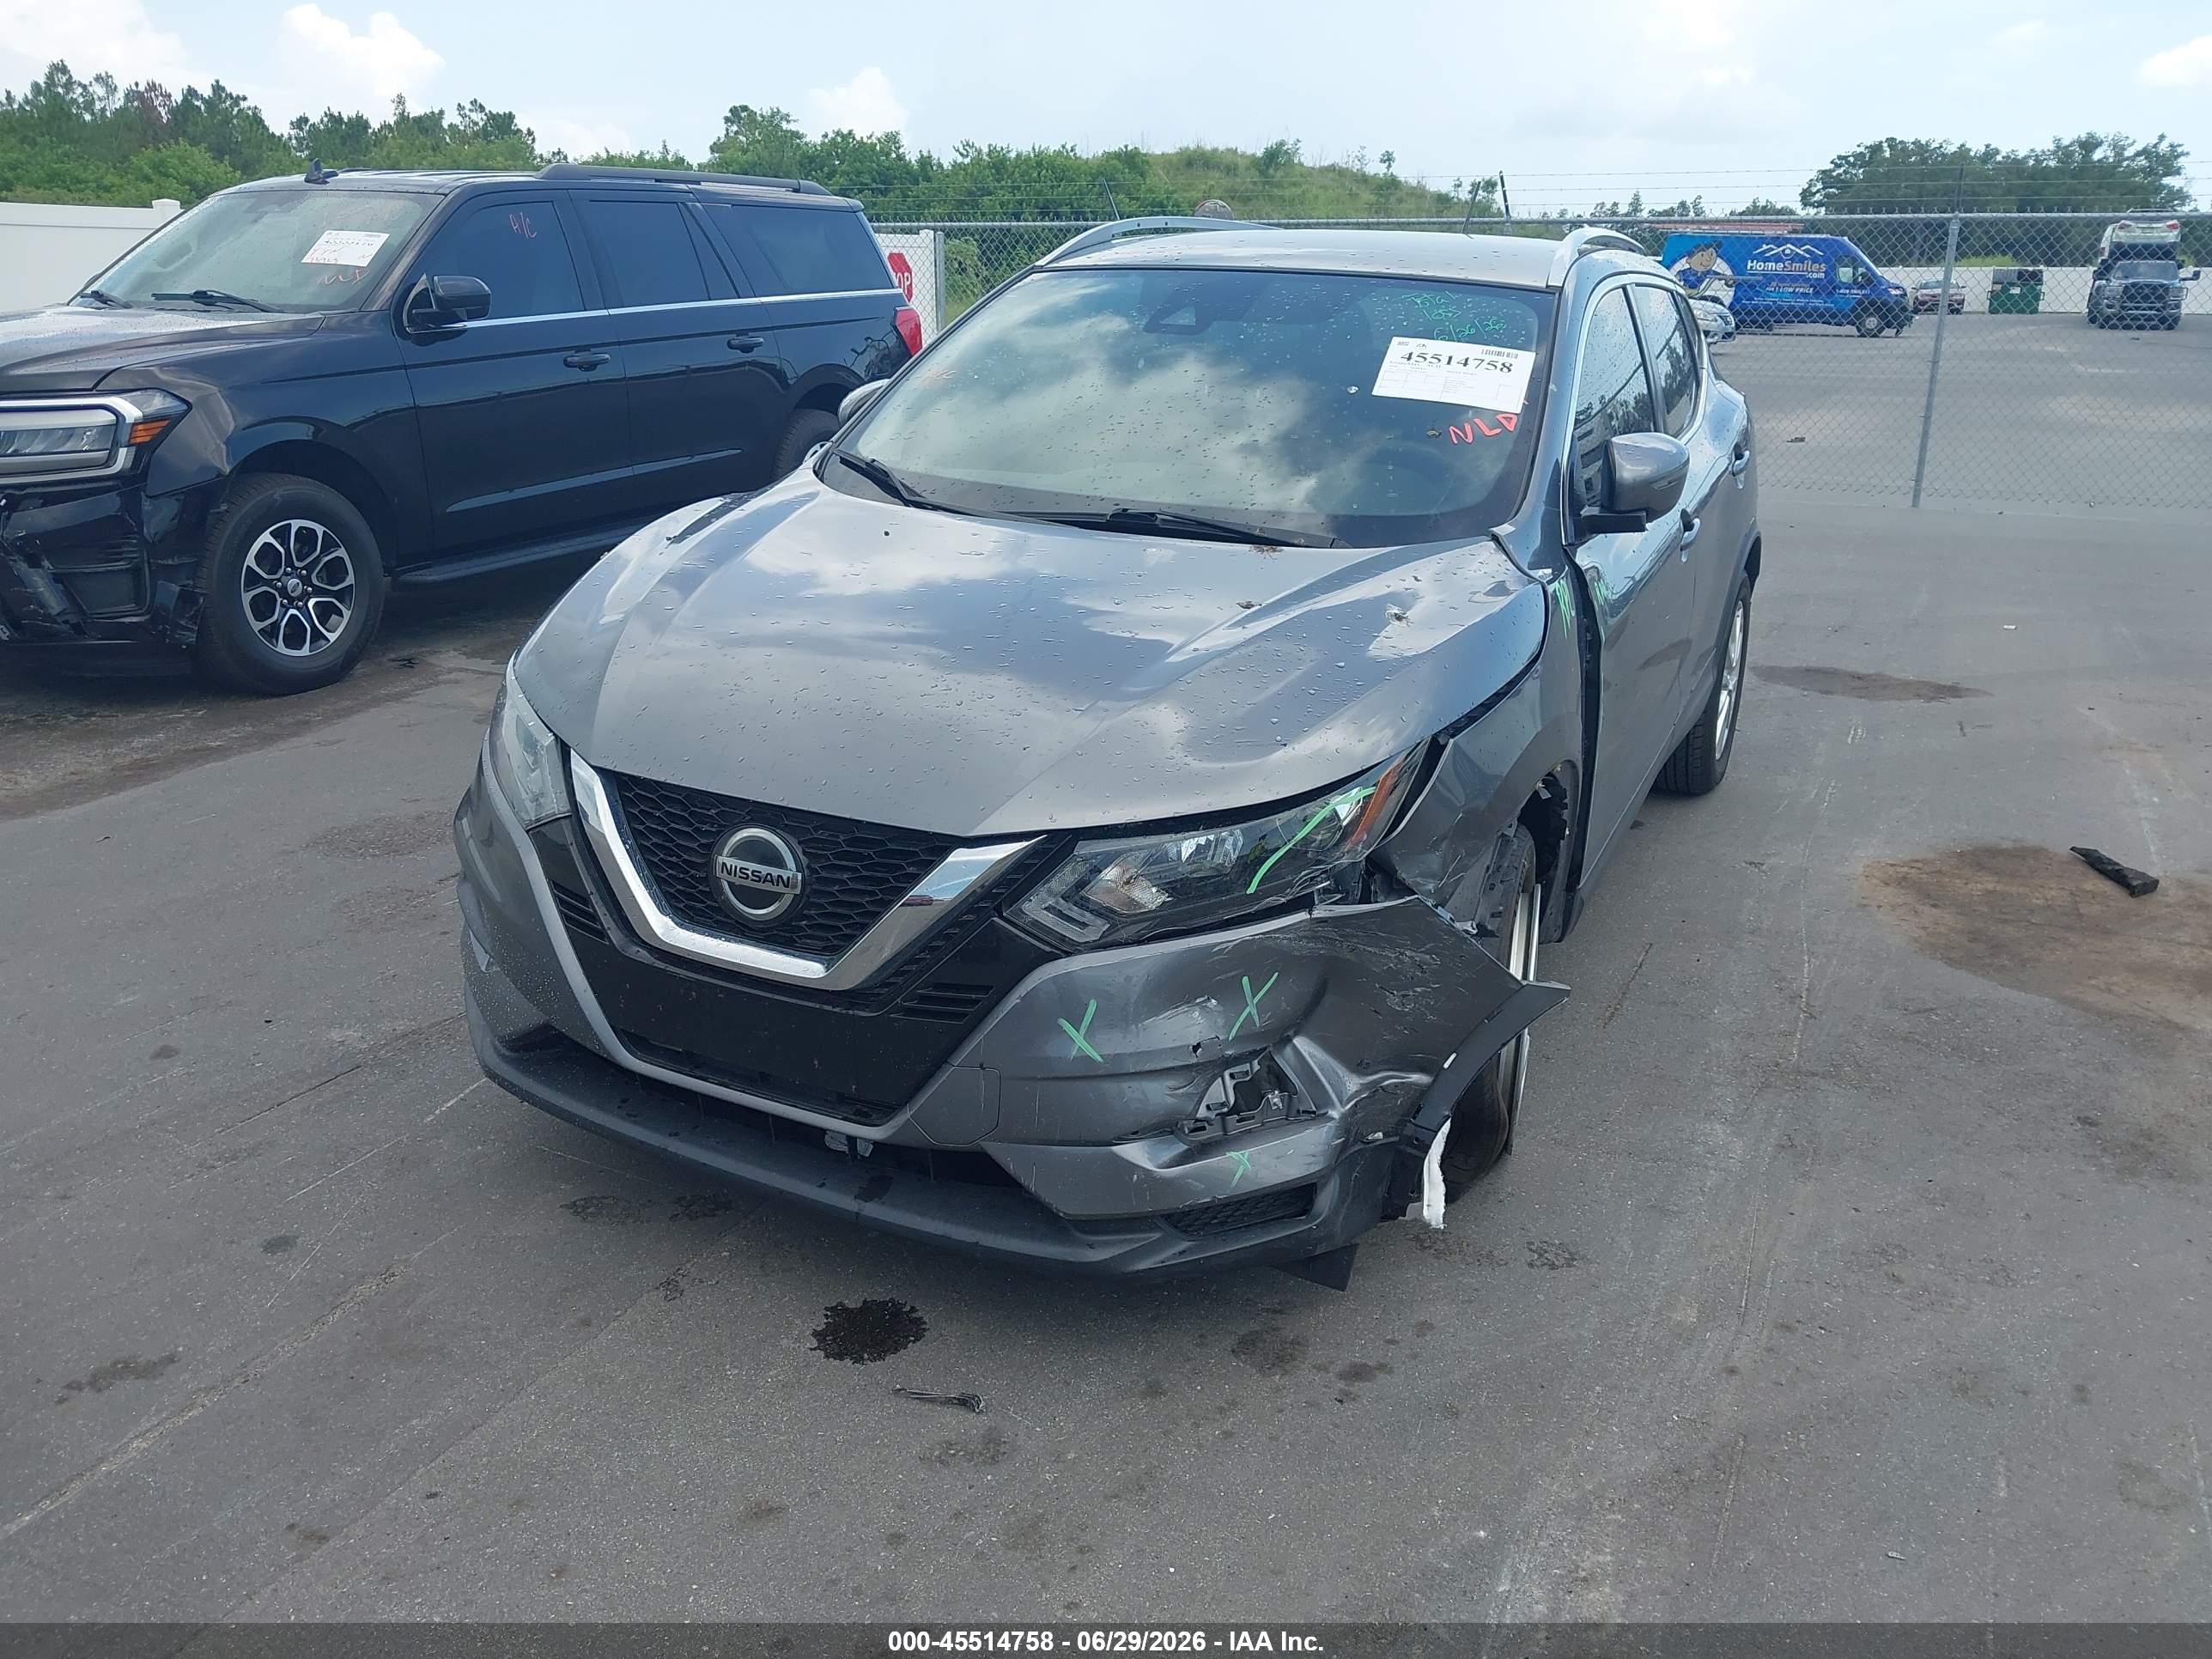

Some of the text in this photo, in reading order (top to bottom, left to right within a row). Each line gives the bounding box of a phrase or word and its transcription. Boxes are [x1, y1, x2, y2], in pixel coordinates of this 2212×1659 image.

[1747, 259, 1827, 272] HomeSmiles
[893, 271, 911, 289] OP
[1401, 351, 1514, 374] 45514758
[720, 861, 791, 889] NISSAN
